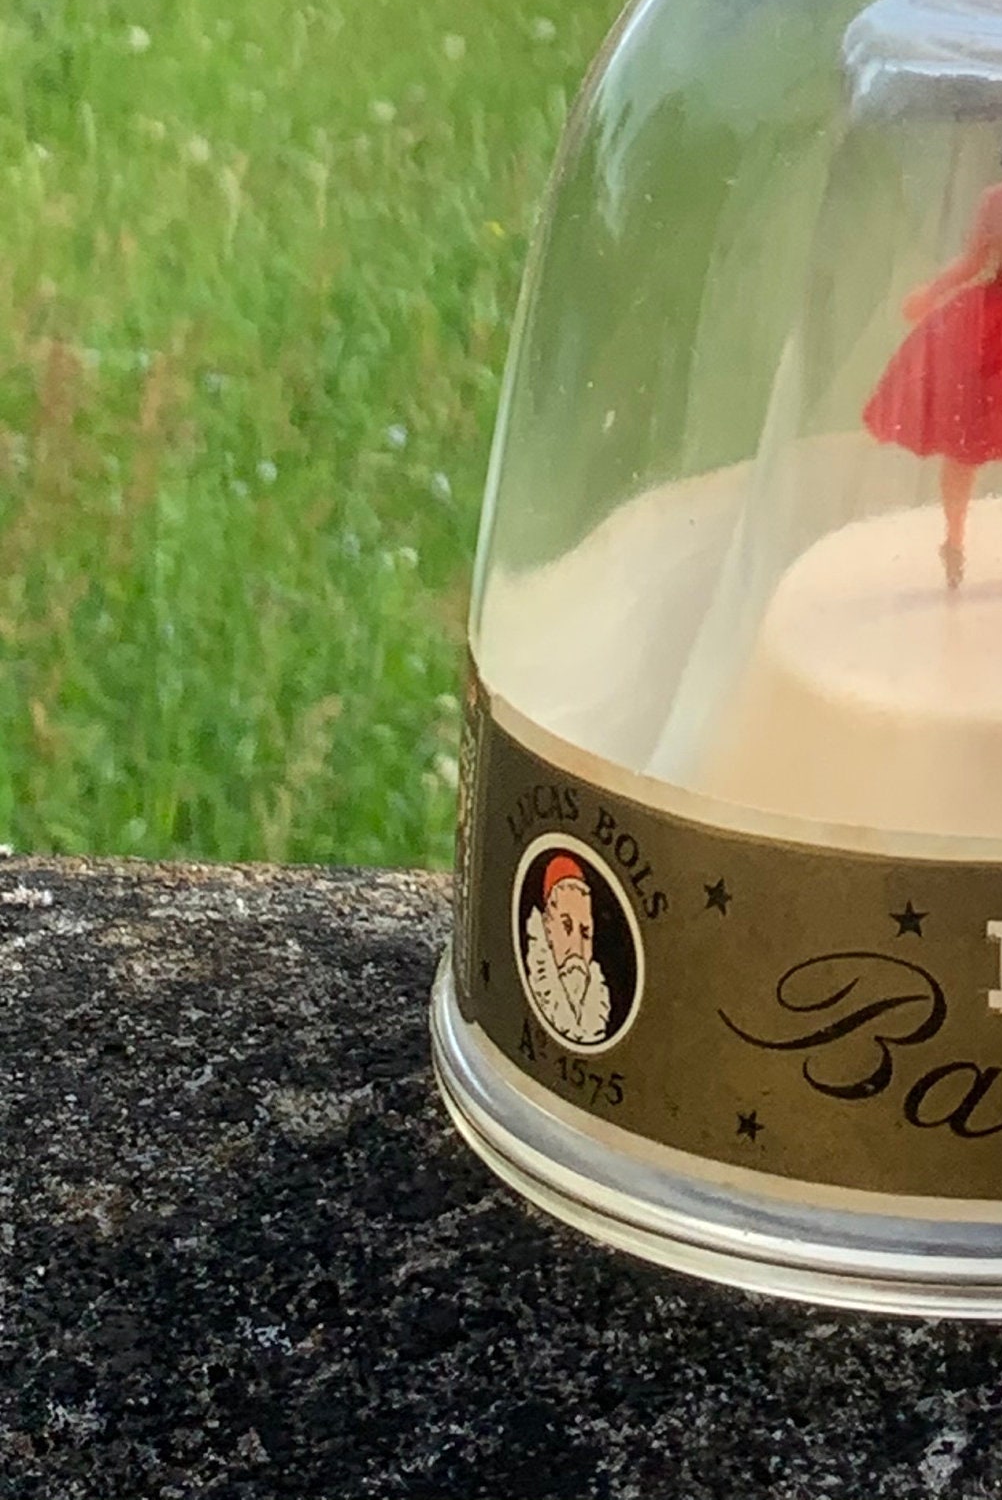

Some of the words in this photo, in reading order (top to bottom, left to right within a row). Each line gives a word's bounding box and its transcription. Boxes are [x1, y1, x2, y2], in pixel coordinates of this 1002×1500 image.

[507, 784, 579, 845] LUCAS
[592, 805, 669, 919] BOLS
[555, 1056, 625, 1106] 1575
